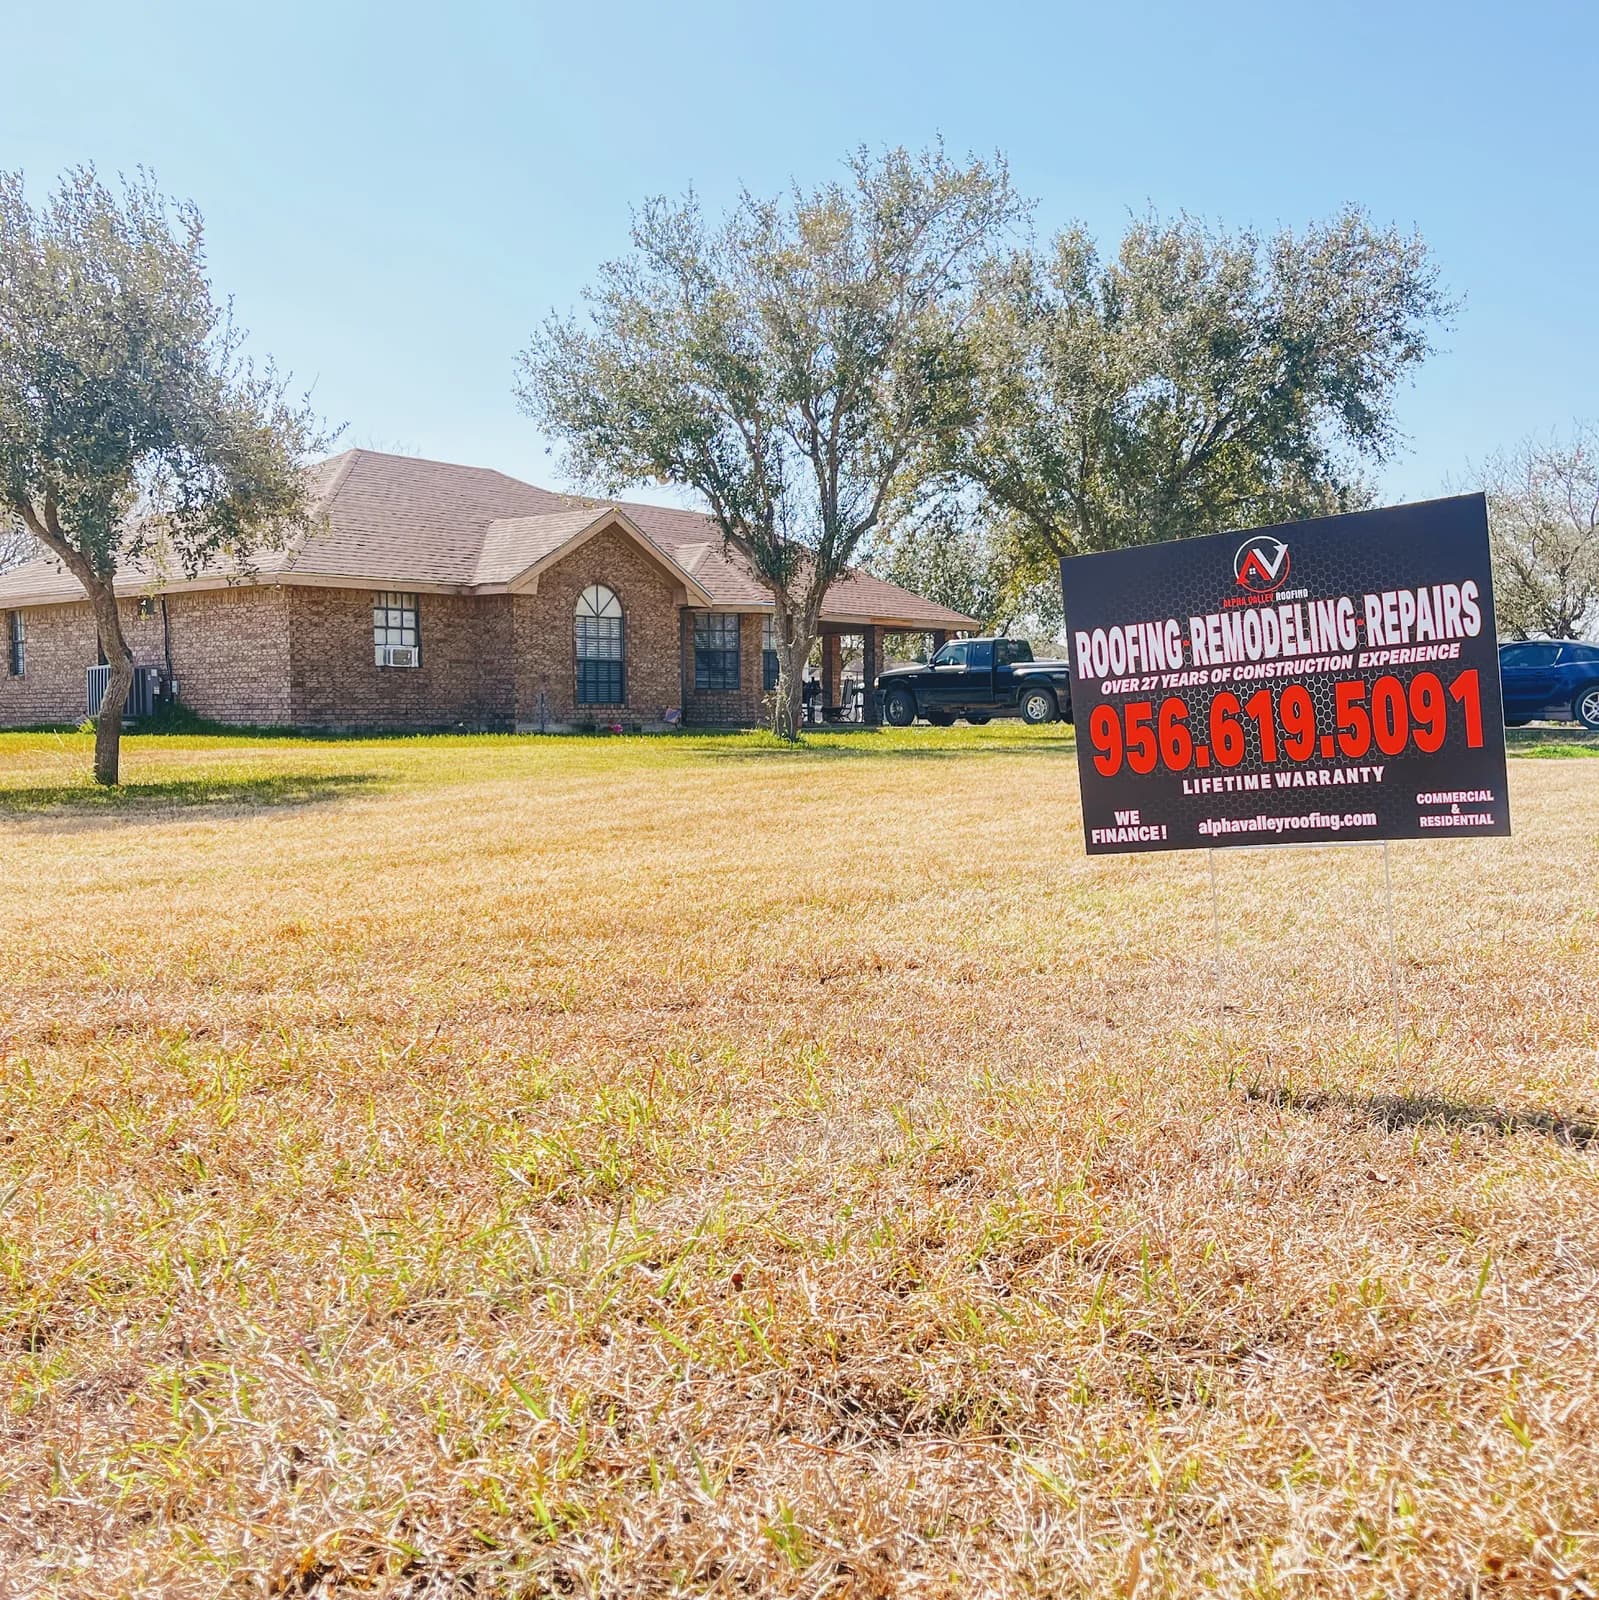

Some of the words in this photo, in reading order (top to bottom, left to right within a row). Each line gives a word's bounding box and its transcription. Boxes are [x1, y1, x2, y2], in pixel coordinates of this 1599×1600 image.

[1275, 588, 1309, 601] ROOFING
[1075, 618, 1183, 680] ROOFING
[1189, 595, 1358, 667] REMODELING
[1363, 580, 1482, 648] REPAIRS
[1101, 679, 1141, 695] OVER
[1141, 676, 1160, 691] 27
[1160, 670, 1209, 689] YEARS
[1210, 667, 1233, 684] OF
[1233, 654, 1354, 681] CONSTRUCTION
[1358, 642, 1461, 669] EXPERIENCE
[1089, 668, 1484, 777] 956.619.5091
[1182, 773, 1272, 795] LIFETIME
[1274, 766, 1385, 788] WARRANTY
[1416, 790, 1494, 805] COMMERCIAL
[1114, 810, 1141, 826] WE
[1451, 803, 1461, 814] &
[1198, 812, 1377, 836] alphavalleyroofing.com
[1419, 814, 1495, 828] RESIDENTIAL
[1091, 825, 1168, 844] FINANCE!
